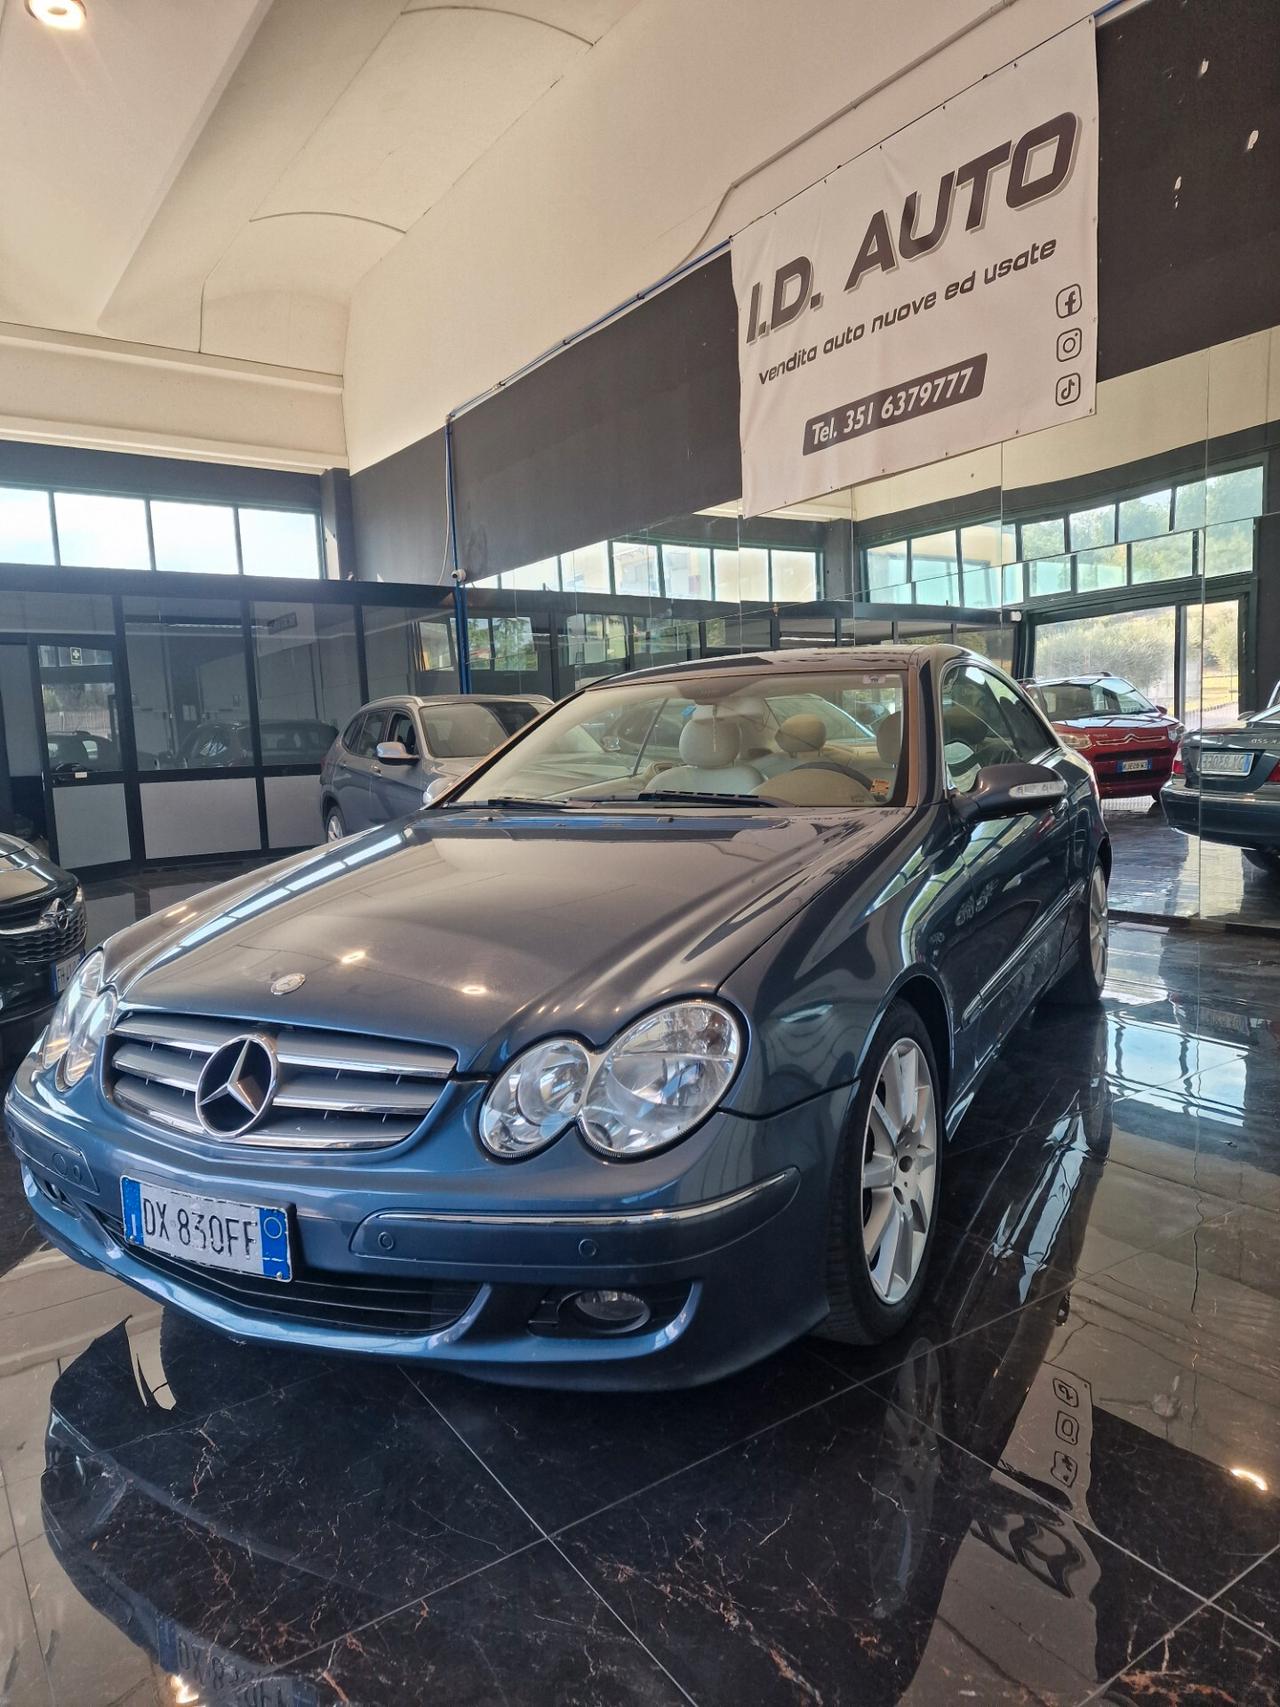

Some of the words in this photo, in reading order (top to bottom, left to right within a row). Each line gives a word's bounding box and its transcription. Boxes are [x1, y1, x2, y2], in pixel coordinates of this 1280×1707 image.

[746, 256, 822, 344] I.D.
[843, 111, 1080, 292] AUTO
[758, 346, 818, 385] vendita
[823, 323, 865, 354] auto
[871, 291, 937, 333] nuove
[944, 270, 976, 301] ed
[983, 239, 1057, 285] usate
[811, 416, 838, 444] Tel.
[843, 401, 874, 434] 351
[881, 366, 975, 419] 6379777
[143, 1198, 169, 1241] DX
[177, 1208, 258, 1259] 830FF
